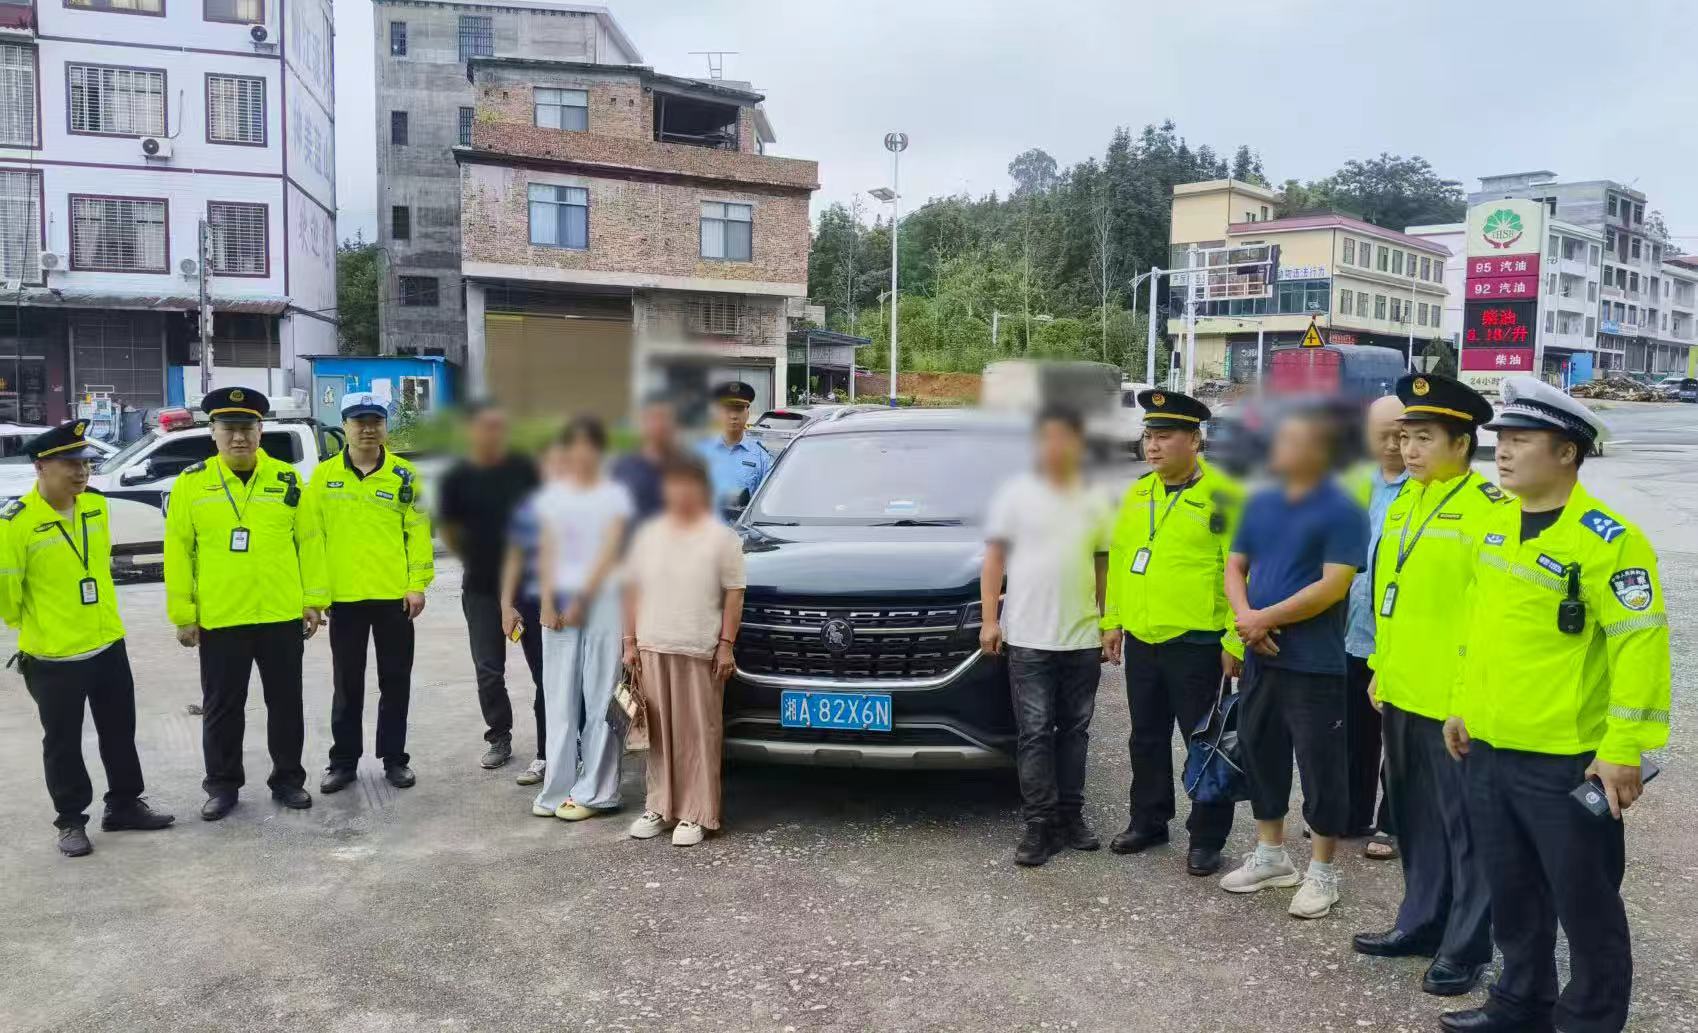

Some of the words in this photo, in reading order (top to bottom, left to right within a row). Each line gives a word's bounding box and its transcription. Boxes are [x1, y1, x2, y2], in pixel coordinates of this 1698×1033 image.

[1476, 262, 1492, 273] 95
[1500, 260, 1527, 272] 汽油
[1474, 283, 1491, 295] 92
[1499, 282, 1526, 294] 汽油
[1496, 354, 1521, 366] 柴油
[1470, 375, 1504, 386] 24小时
